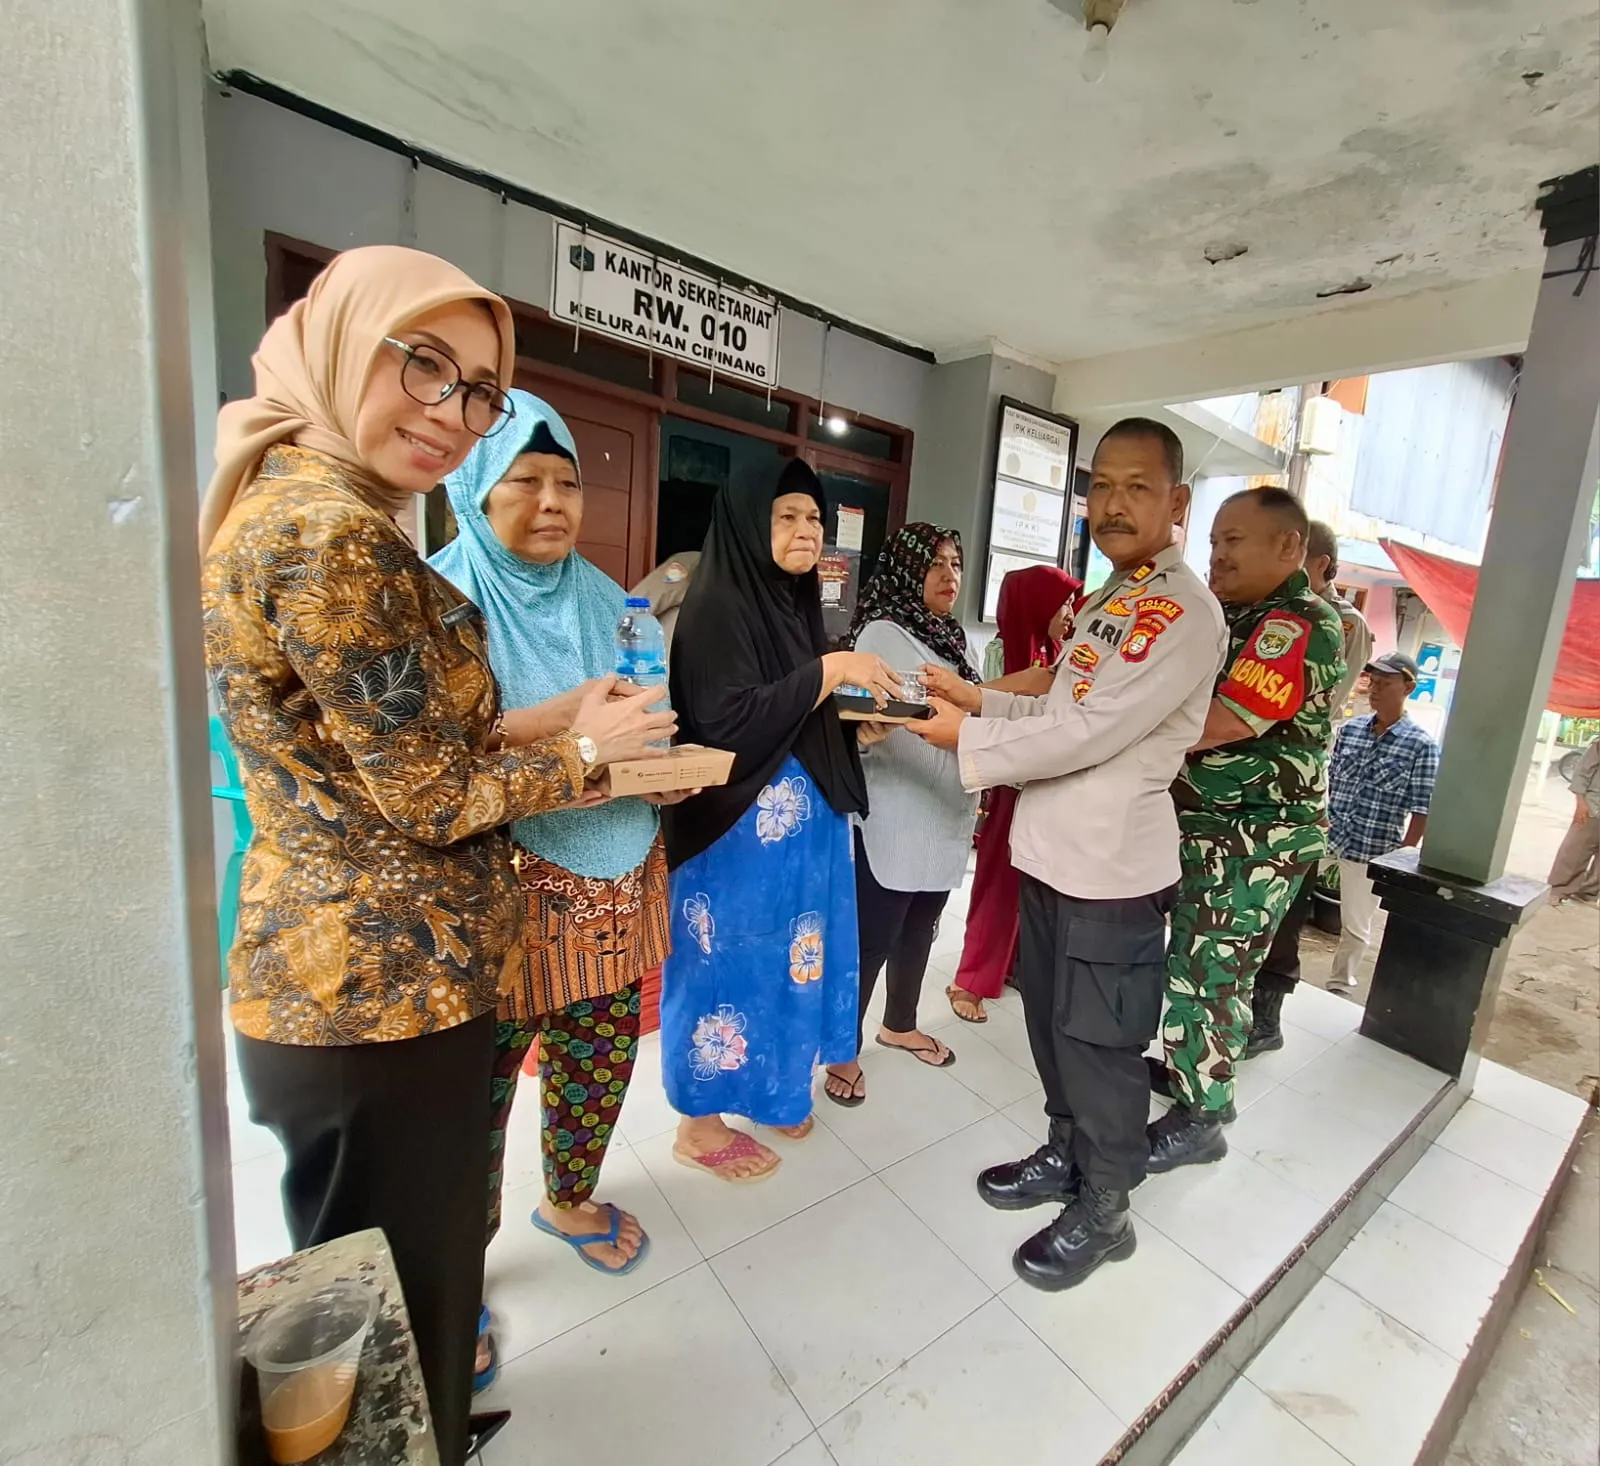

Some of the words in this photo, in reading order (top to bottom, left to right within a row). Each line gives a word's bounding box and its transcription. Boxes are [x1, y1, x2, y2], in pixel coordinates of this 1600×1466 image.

[605, 250, 672, 293] KANTOR
[678, 278, 772, 329] SEKRETARIAT
[633, 288, 689, 333] RW.
[700, 313, 747, 352] 010
[569, 300, 686, 352] KELURAHAN
[692, 342, 766, 377] CIPINANG
